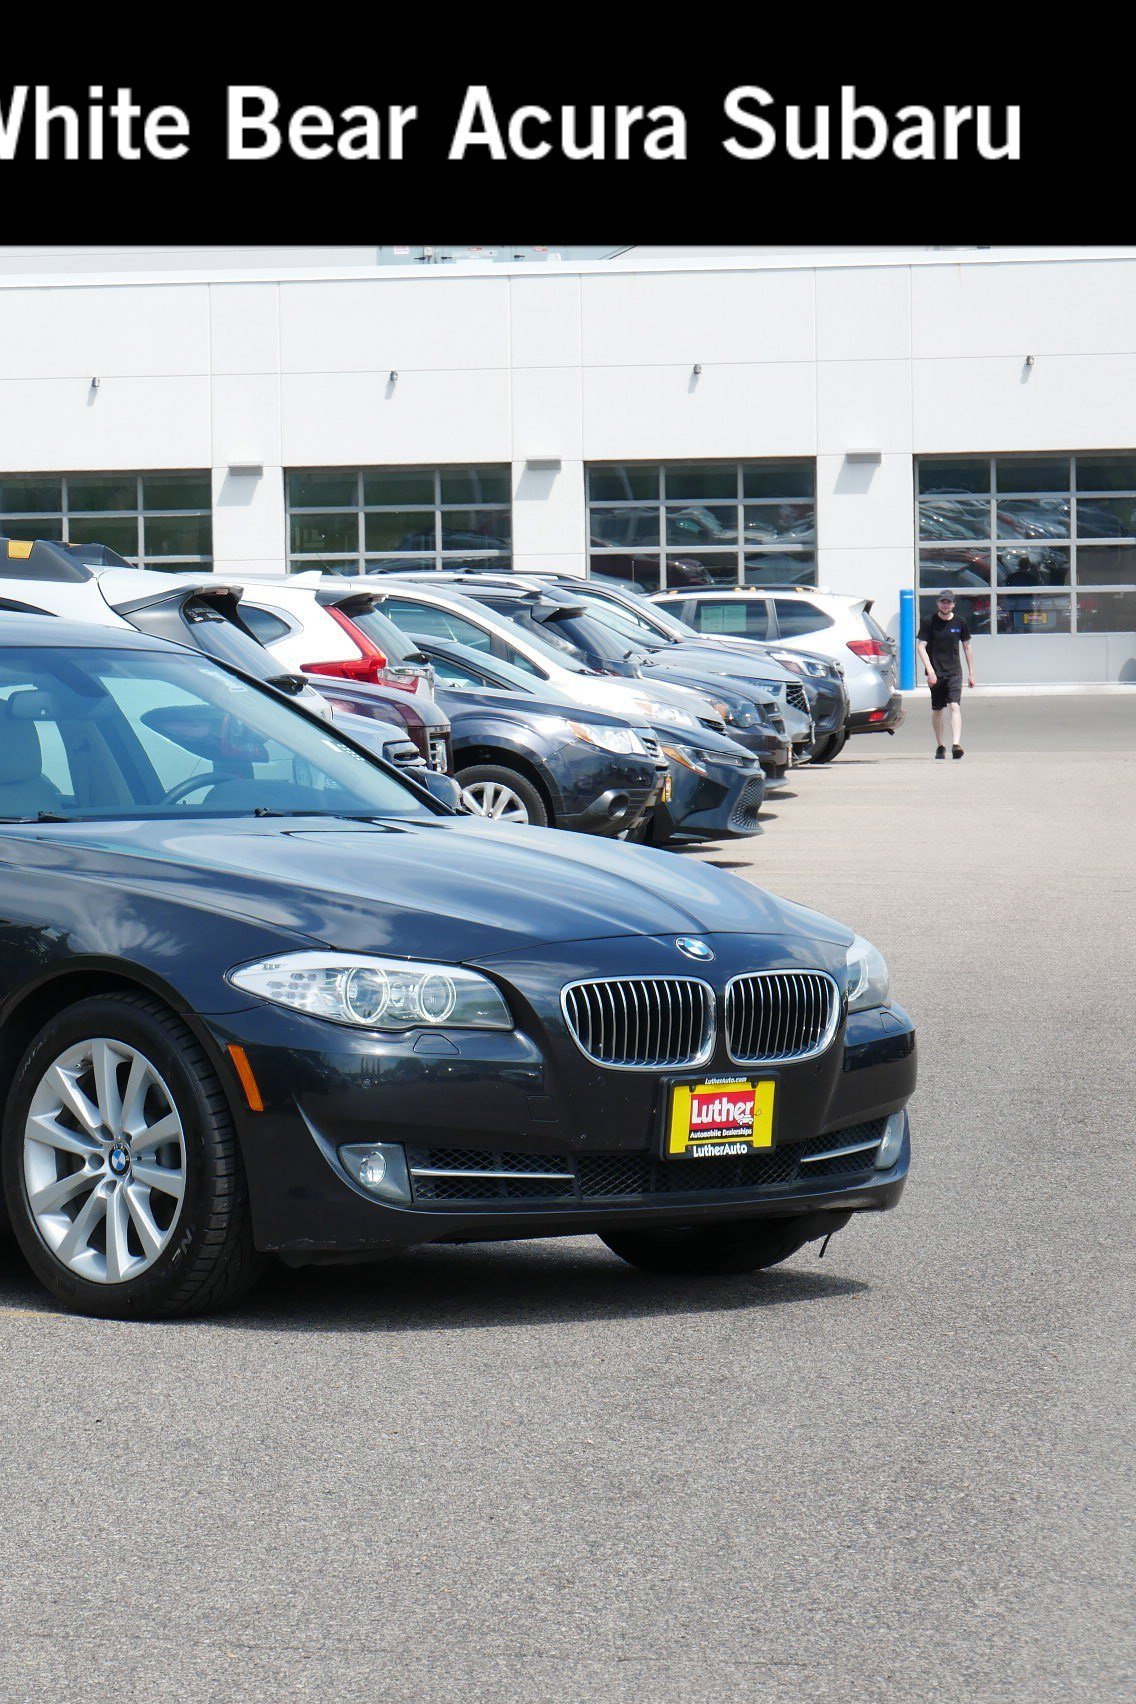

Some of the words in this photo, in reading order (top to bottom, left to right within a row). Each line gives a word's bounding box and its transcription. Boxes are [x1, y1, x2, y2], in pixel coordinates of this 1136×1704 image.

[691, 1097, 754, 1124] Luther
[690, 1129, 721, 1139] Automobile
[722, 1128, 752, 1137] Dealerships
[693, 1143, 748, 1158] LutherAuto
